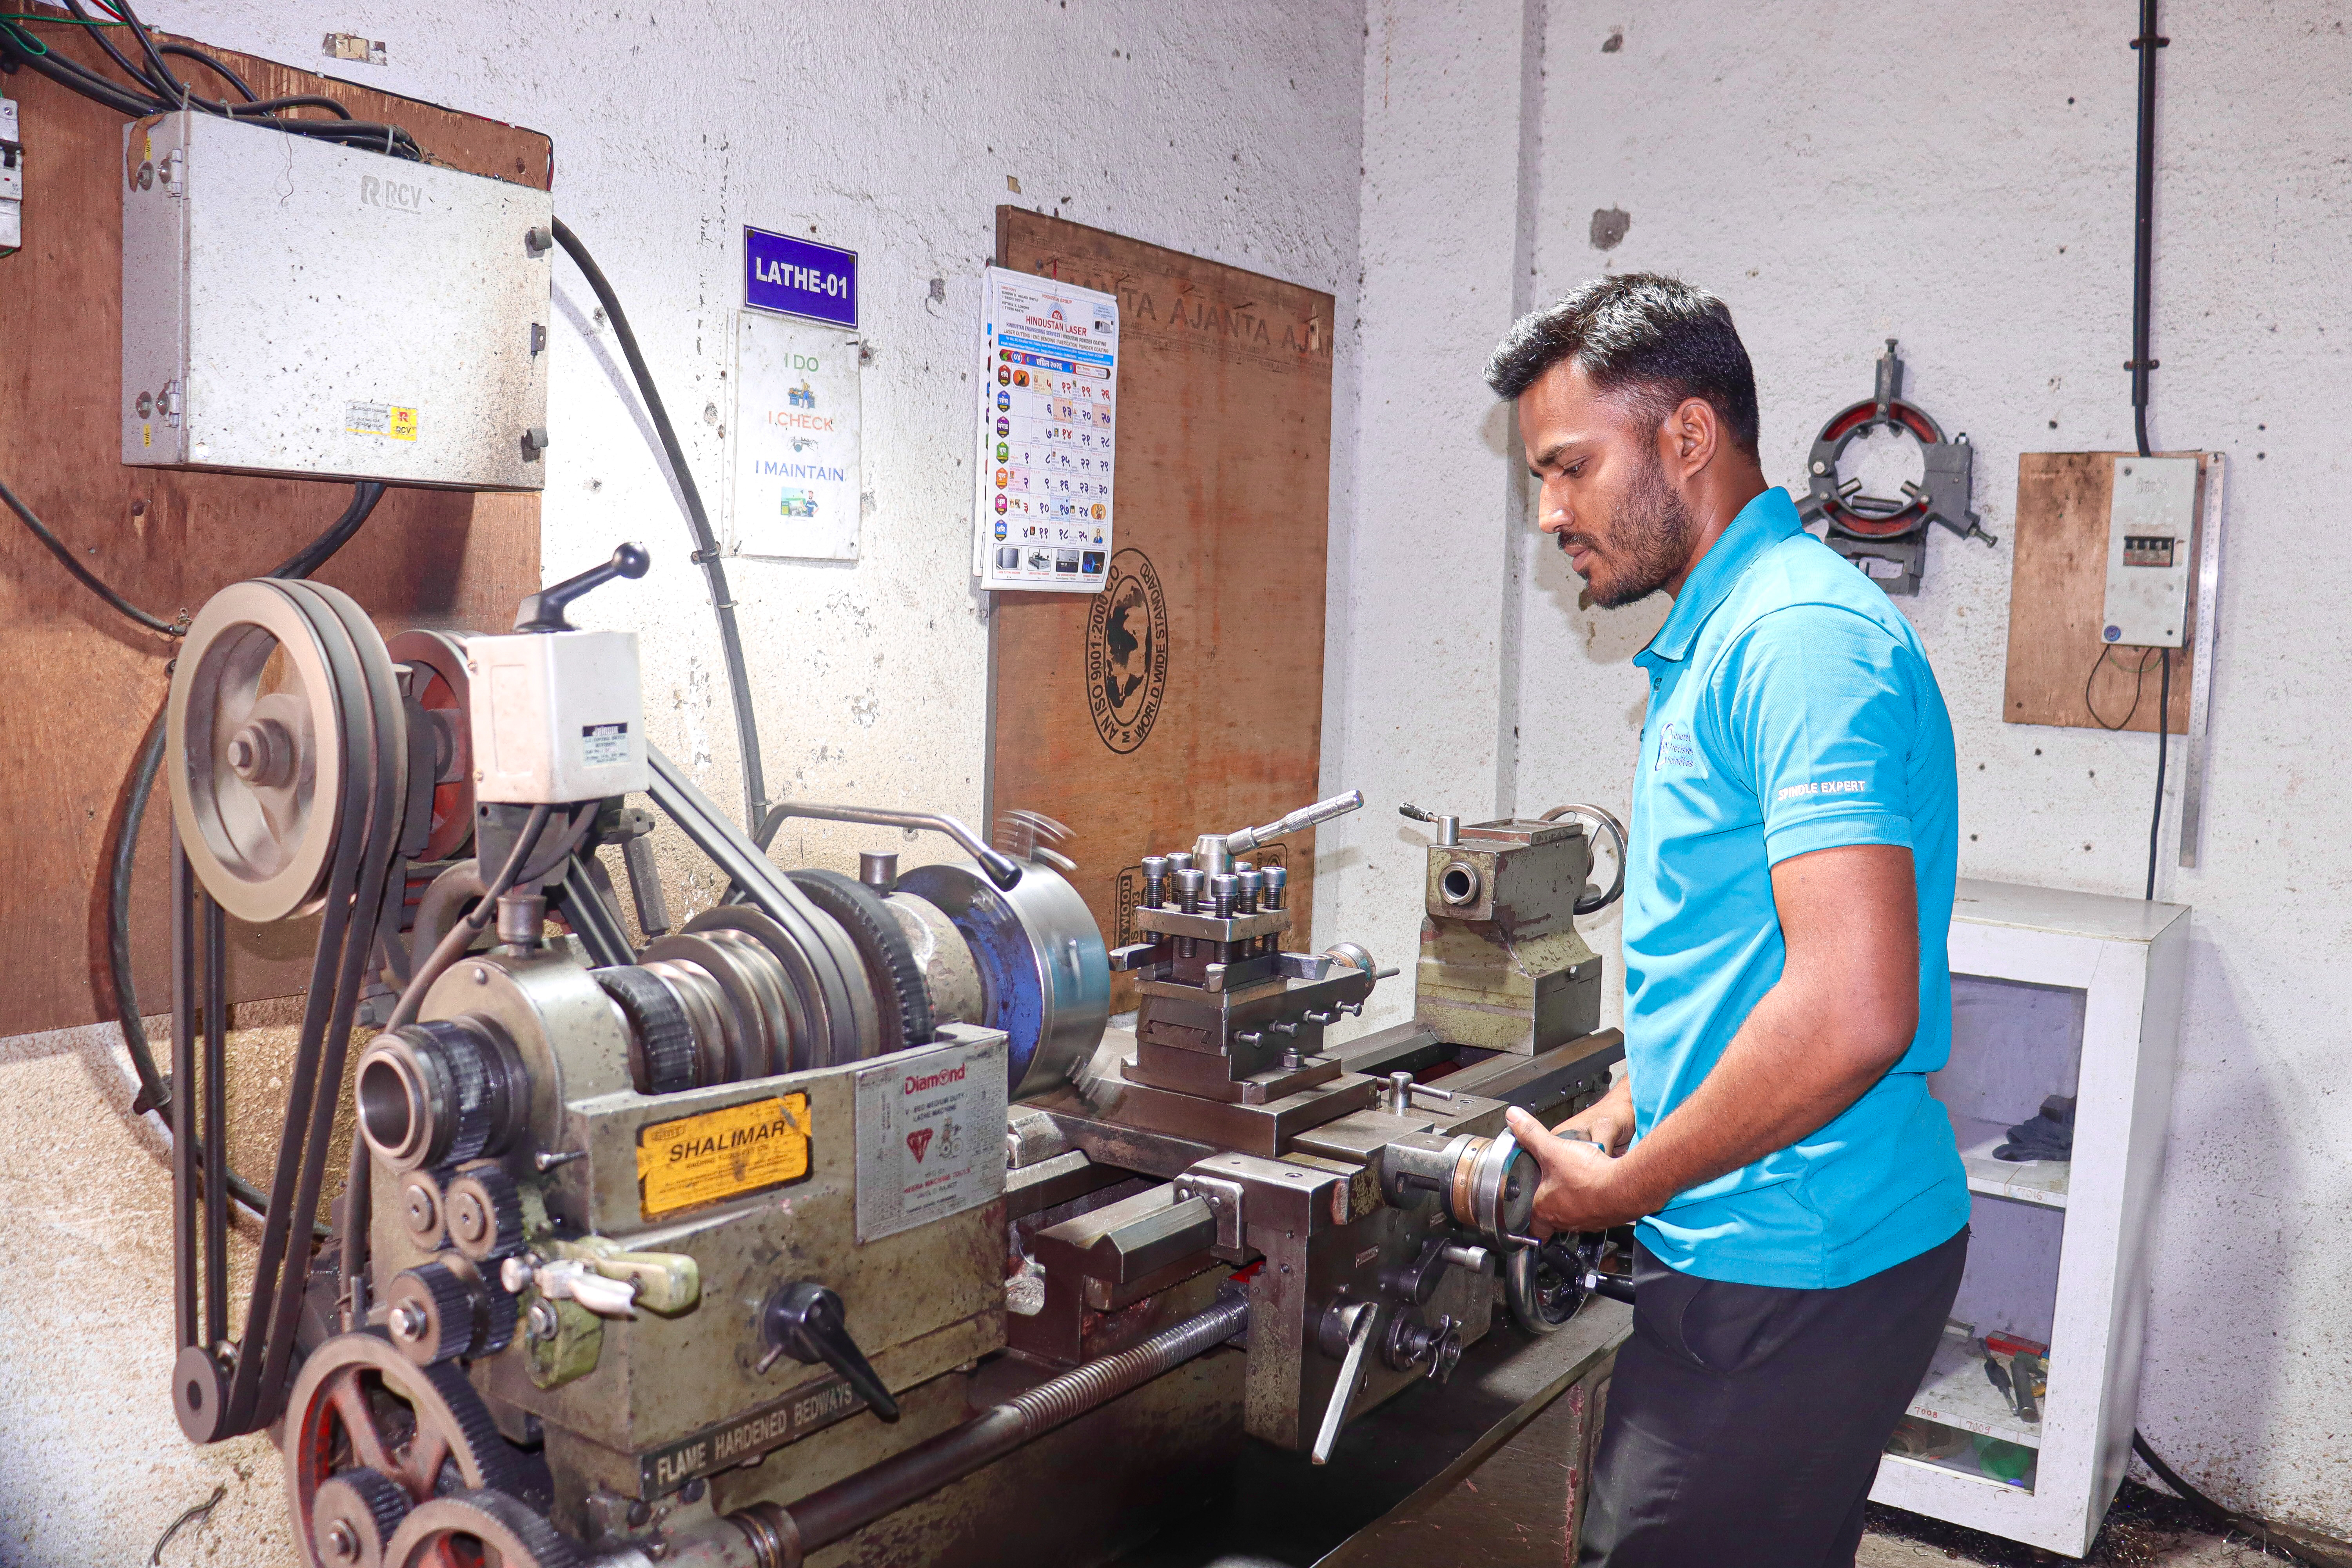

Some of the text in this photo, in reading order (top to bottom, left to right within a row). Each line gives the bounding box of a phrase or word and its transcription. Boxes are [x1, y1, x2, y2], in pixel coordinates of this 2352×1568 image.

[385, 180, 423, 209] RCV
[755, 257, 848, 299] LATHE-01
[1042, 294, 1059, 302] HINDUSTAN
[1006, 322, 1024, 331] HINDUSTAN
[1025, 326, 1045, 335] ENGINEERING
[1026, 315, 1087, 337] HINDUSTAN LASER
[1170, 298, 1270, 345] AJANTA
[784, 352, 820, 373] I DO
[1036, 358, 1050, 367] एप्रिल
[1050, 361, 1062, 371] २०२६
[1047, 379, 1052, 391] ५
[1062, 382, 1071, 394] १२
[1082, 386, 1091, 397] १९
[1101, 389, 1110, 402] २६
[769, 410, 835, 432] I CHECK
[1047, 404, 1052, 416] ६
[1063, 406, 1072, 418] १३
[1082, 410, 1091, 421] २०
[1101, 413, 1110, 424] २७
[1046, 428, 1052, 439] ७
[1062, 428, 1072, 440] १४
[1082, 434, 1091, 446] २१
[1101, 437, 1110, 448] २८
[755, 460, 844, 482] I MAINTAIN
[1025, 452, 1029, 464] १
[1045, 454, 1051, 464] ८
[1061, 455, 1070, 467] १५
[1081, 458, 1090, 470] २२
[1100, 461, 1109, 472] २९
[1024, 477, 1029, 489] २
[1045, 478, 1049, 489] ९
[1060, 480, 1069, 492] १६
[1080, 483, 1089, 494] २३
[1099, 485, 1107, 496] ३०
[997, 498, 1088, 517] शुक्र ३ १० १७ २४
[1022, 528, 1028, 538] ४
[1039, 527, 1048, 539] ११
[1059, 529, 1068, 540] १८
[1079, 531, 1088, 542] २५
[1090, 594, 1108, 681] 9001:2000
[1134, 563, 1165, 739] WORLD WIDE STANDARD
[1092, 685, 1107, 717] ISO
[1101, 714, 1119, 740] AN
[1777, 780, 1866, 801] SPINDLE EXPERT
[1120, 879, 1130, 946] YWOOD
[905, 1062, 965, 1095] Diamond
[926, 1097, 949, 1109] MEDIUM
[949, 1092, 965, 1102] DUTY
[913, 1103, 956, 1122] LATHE MACHINE
[670, 1119, 785, 1162] SHALIMAR
[925, 1174, 951, 1187] MACHINE
[2017, 1188, 2045, 1201] 7016
[1915, 1406, 1938, 1419] 7008
[657, 1382, 853, 1485] FLAME HARDENED BEDWAYS
[1966, 1420, 1992, 1434] 7009
